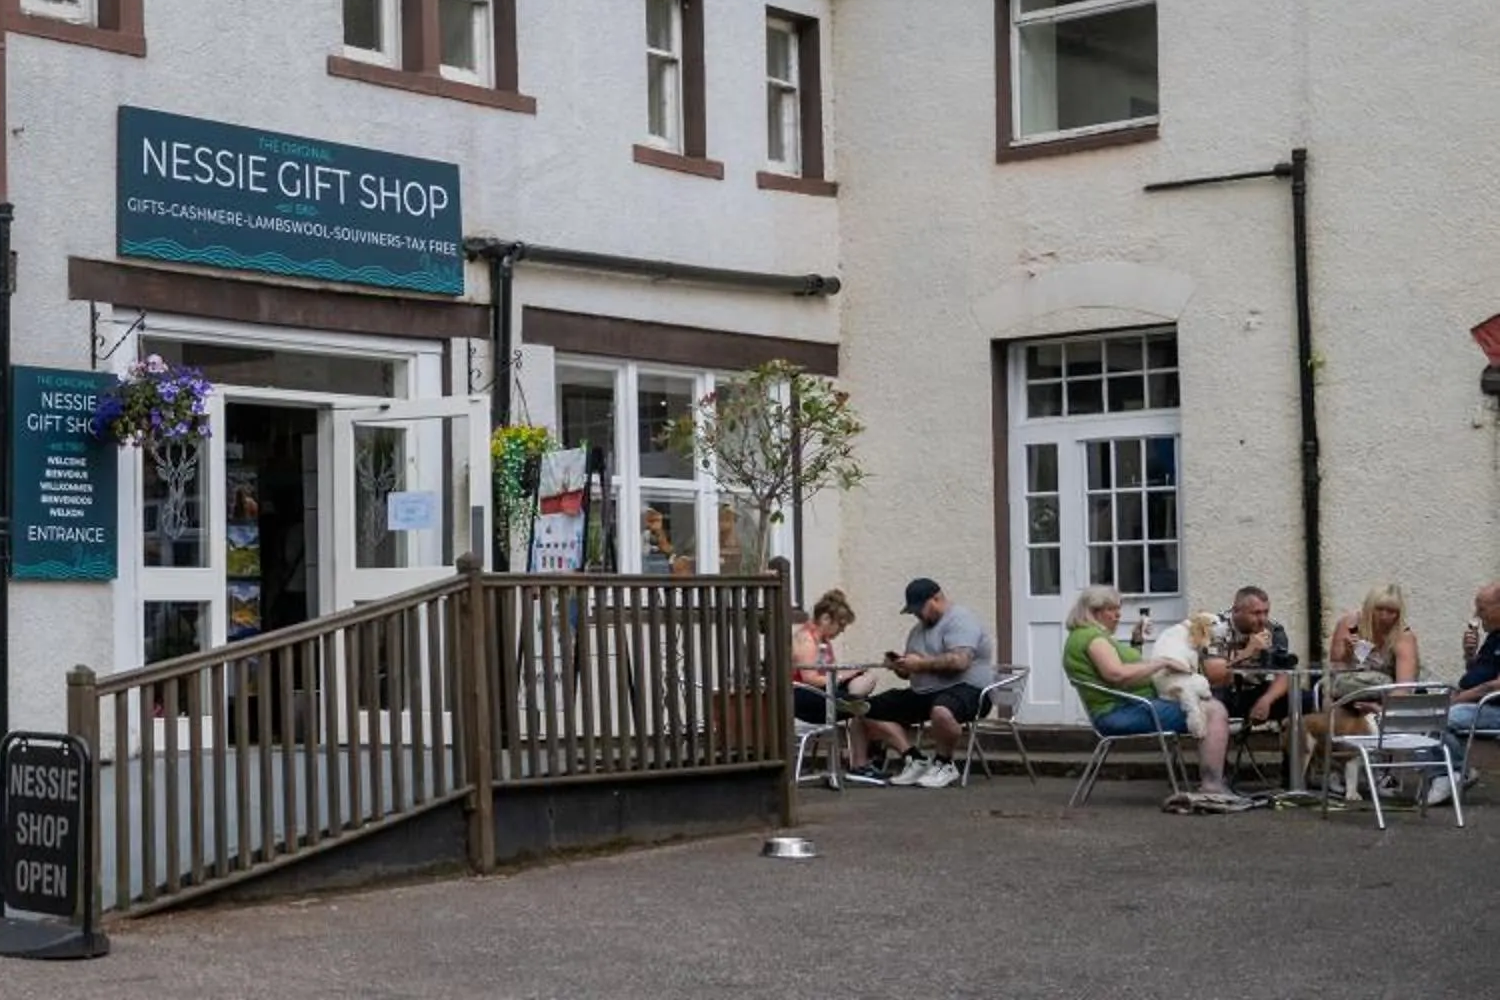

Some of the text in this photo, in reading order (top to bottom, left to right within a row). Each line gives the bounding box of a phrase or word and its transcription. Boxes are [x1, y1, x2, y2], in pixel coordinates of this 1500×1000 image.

[259, 136, 280, 153] THE
[142, 137, 449, 219] NESSIE GIFT SHOP
[429, 239, 457, 257] FREE
[41, 391, 97, 412] NESSIE
[27, 413, 97, 435] GIFT SHO
[27, 525, 105, 543] ENTRANCE
[10, 763, 79, 801] NESSIE
[15, 811, 70, 849] SHOP
[15, 859, 68, 898] OPEN
